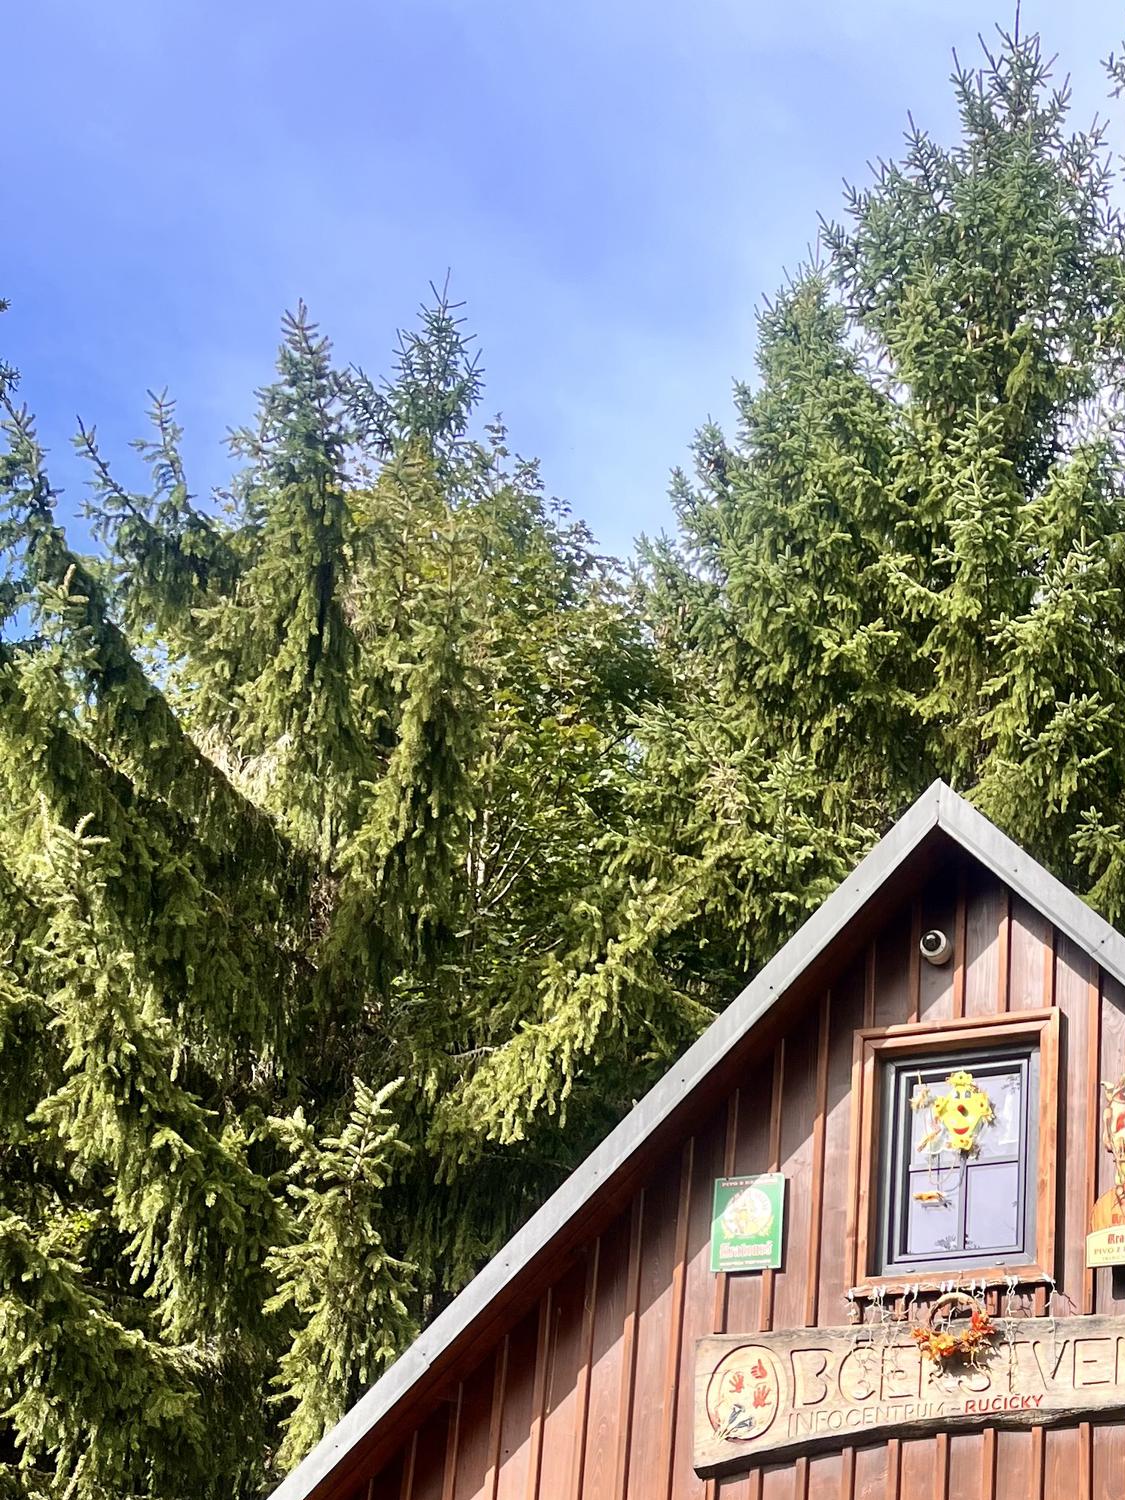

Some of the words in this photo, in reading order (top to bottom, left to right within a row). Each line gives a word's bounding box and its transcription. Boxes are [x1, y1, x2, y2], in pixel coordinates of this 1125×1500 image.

[1094, 1247, 1114, 1255] PIVO
[786, 1402, 946, 1440] INFOCENTRUM
[964, 1393, 1045, 1415] RUČIČKY
